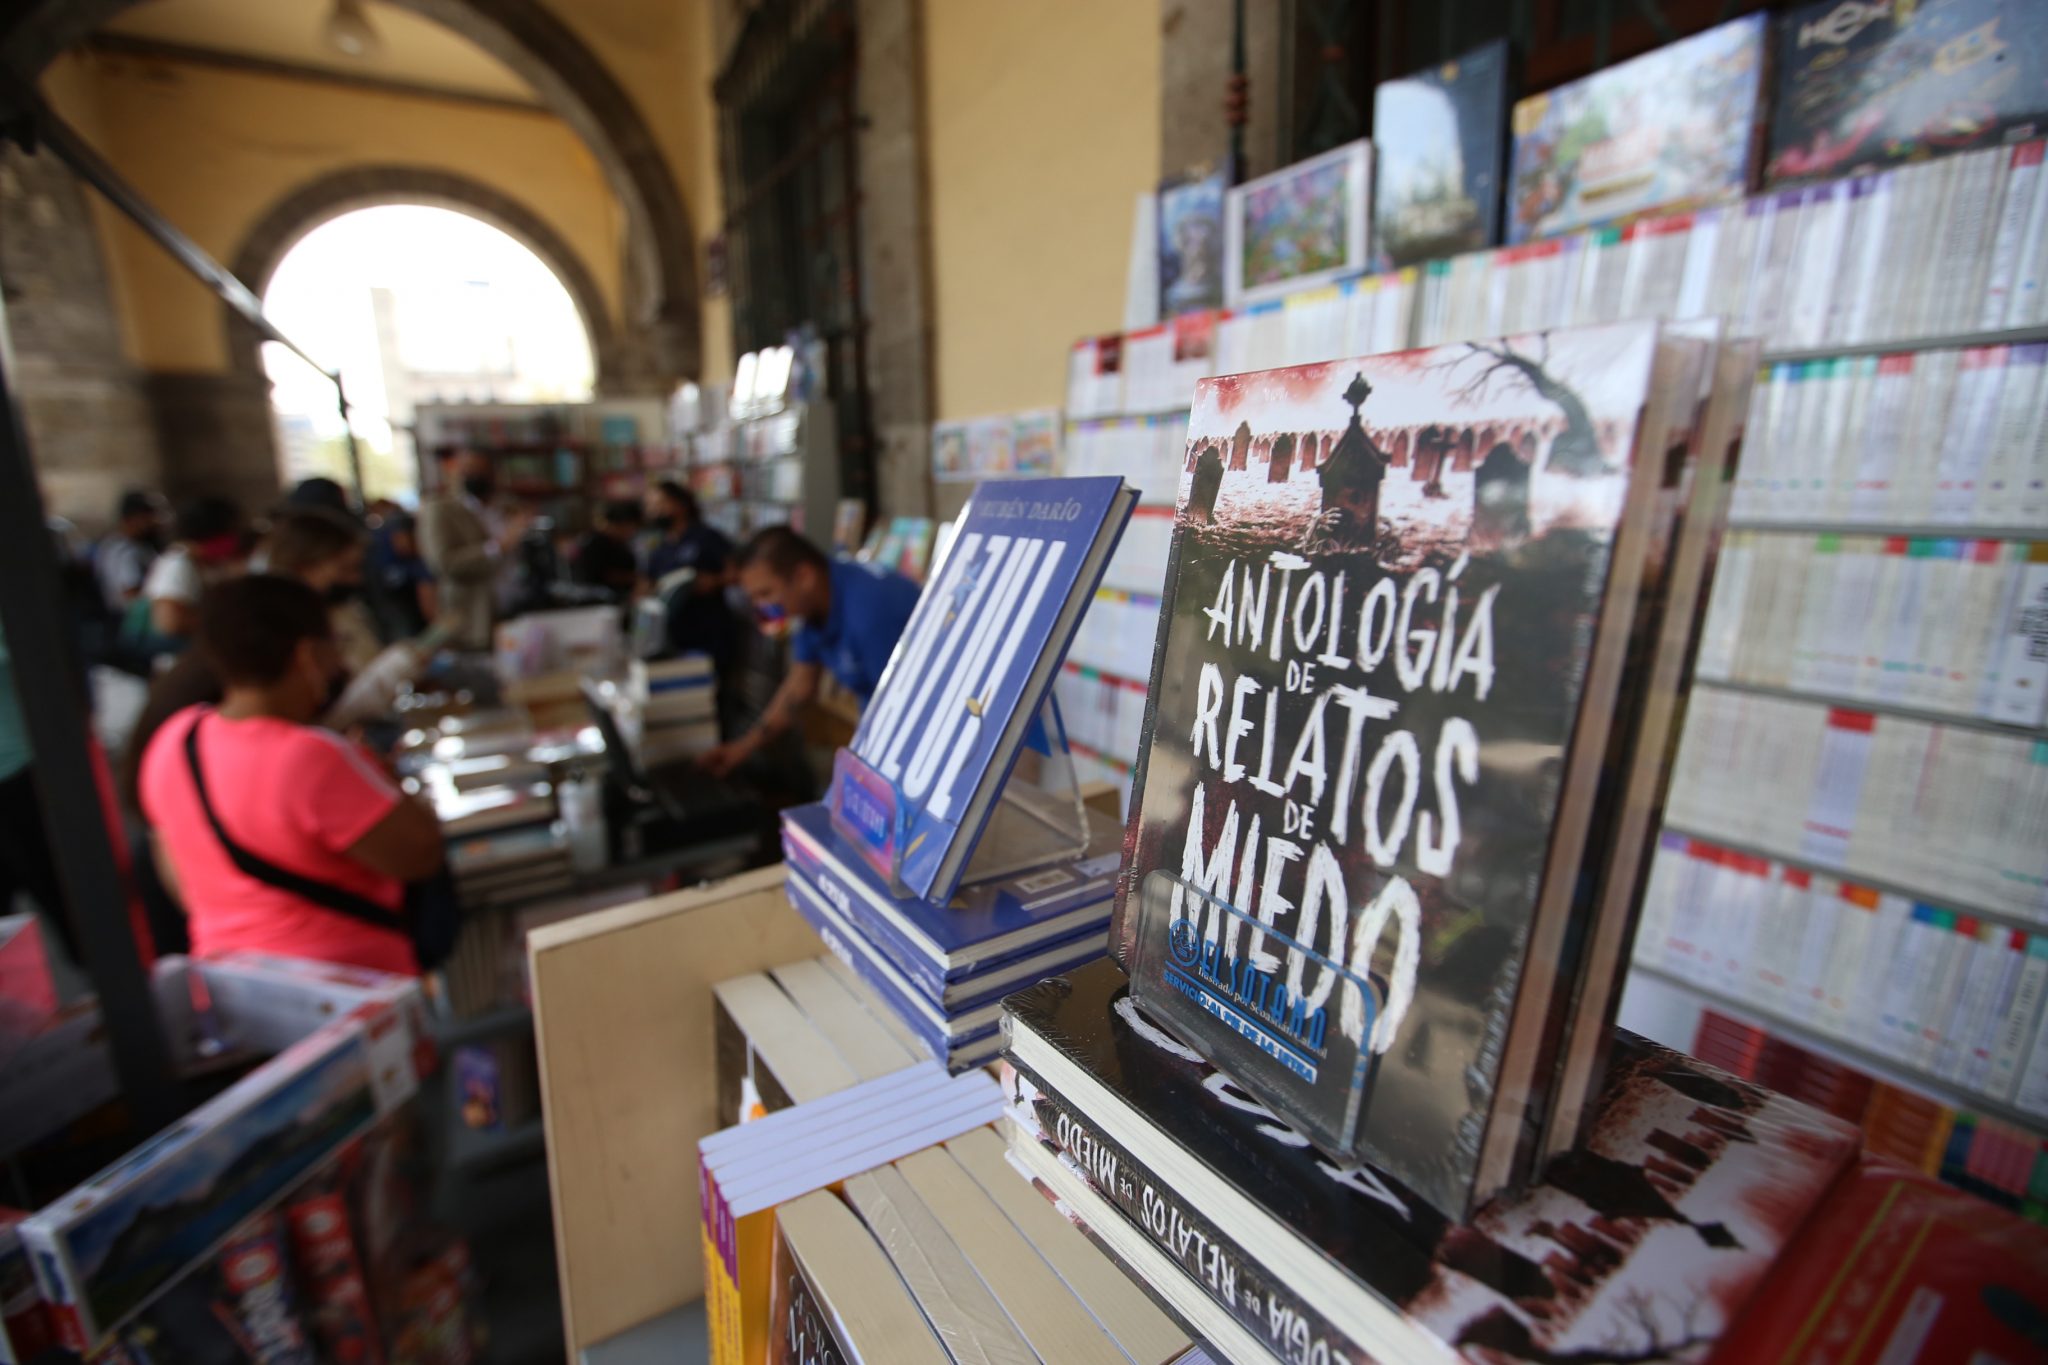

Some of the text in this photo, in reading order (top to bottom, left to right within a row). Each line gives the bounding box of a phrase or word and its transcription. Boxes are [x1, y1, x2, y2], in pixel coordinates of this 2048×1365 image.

[1027, 497, 1083, 522] DARÍO
[1203, 552, 1500, 701] ANTOLOGÍA
[1286, 660, 1316, 695] DE
[1190, 662, 1479, 878] RELATOS
[1283, 799, 1315, 841] DE
[1170, 782, 1421, 1055] MIEDO
[1163, 970, 1207, 1007] SERVICIO
[1057, 1112, 1117, 1196] MIEDO
[1141, 1184, 1237, 1307] RELATOS
